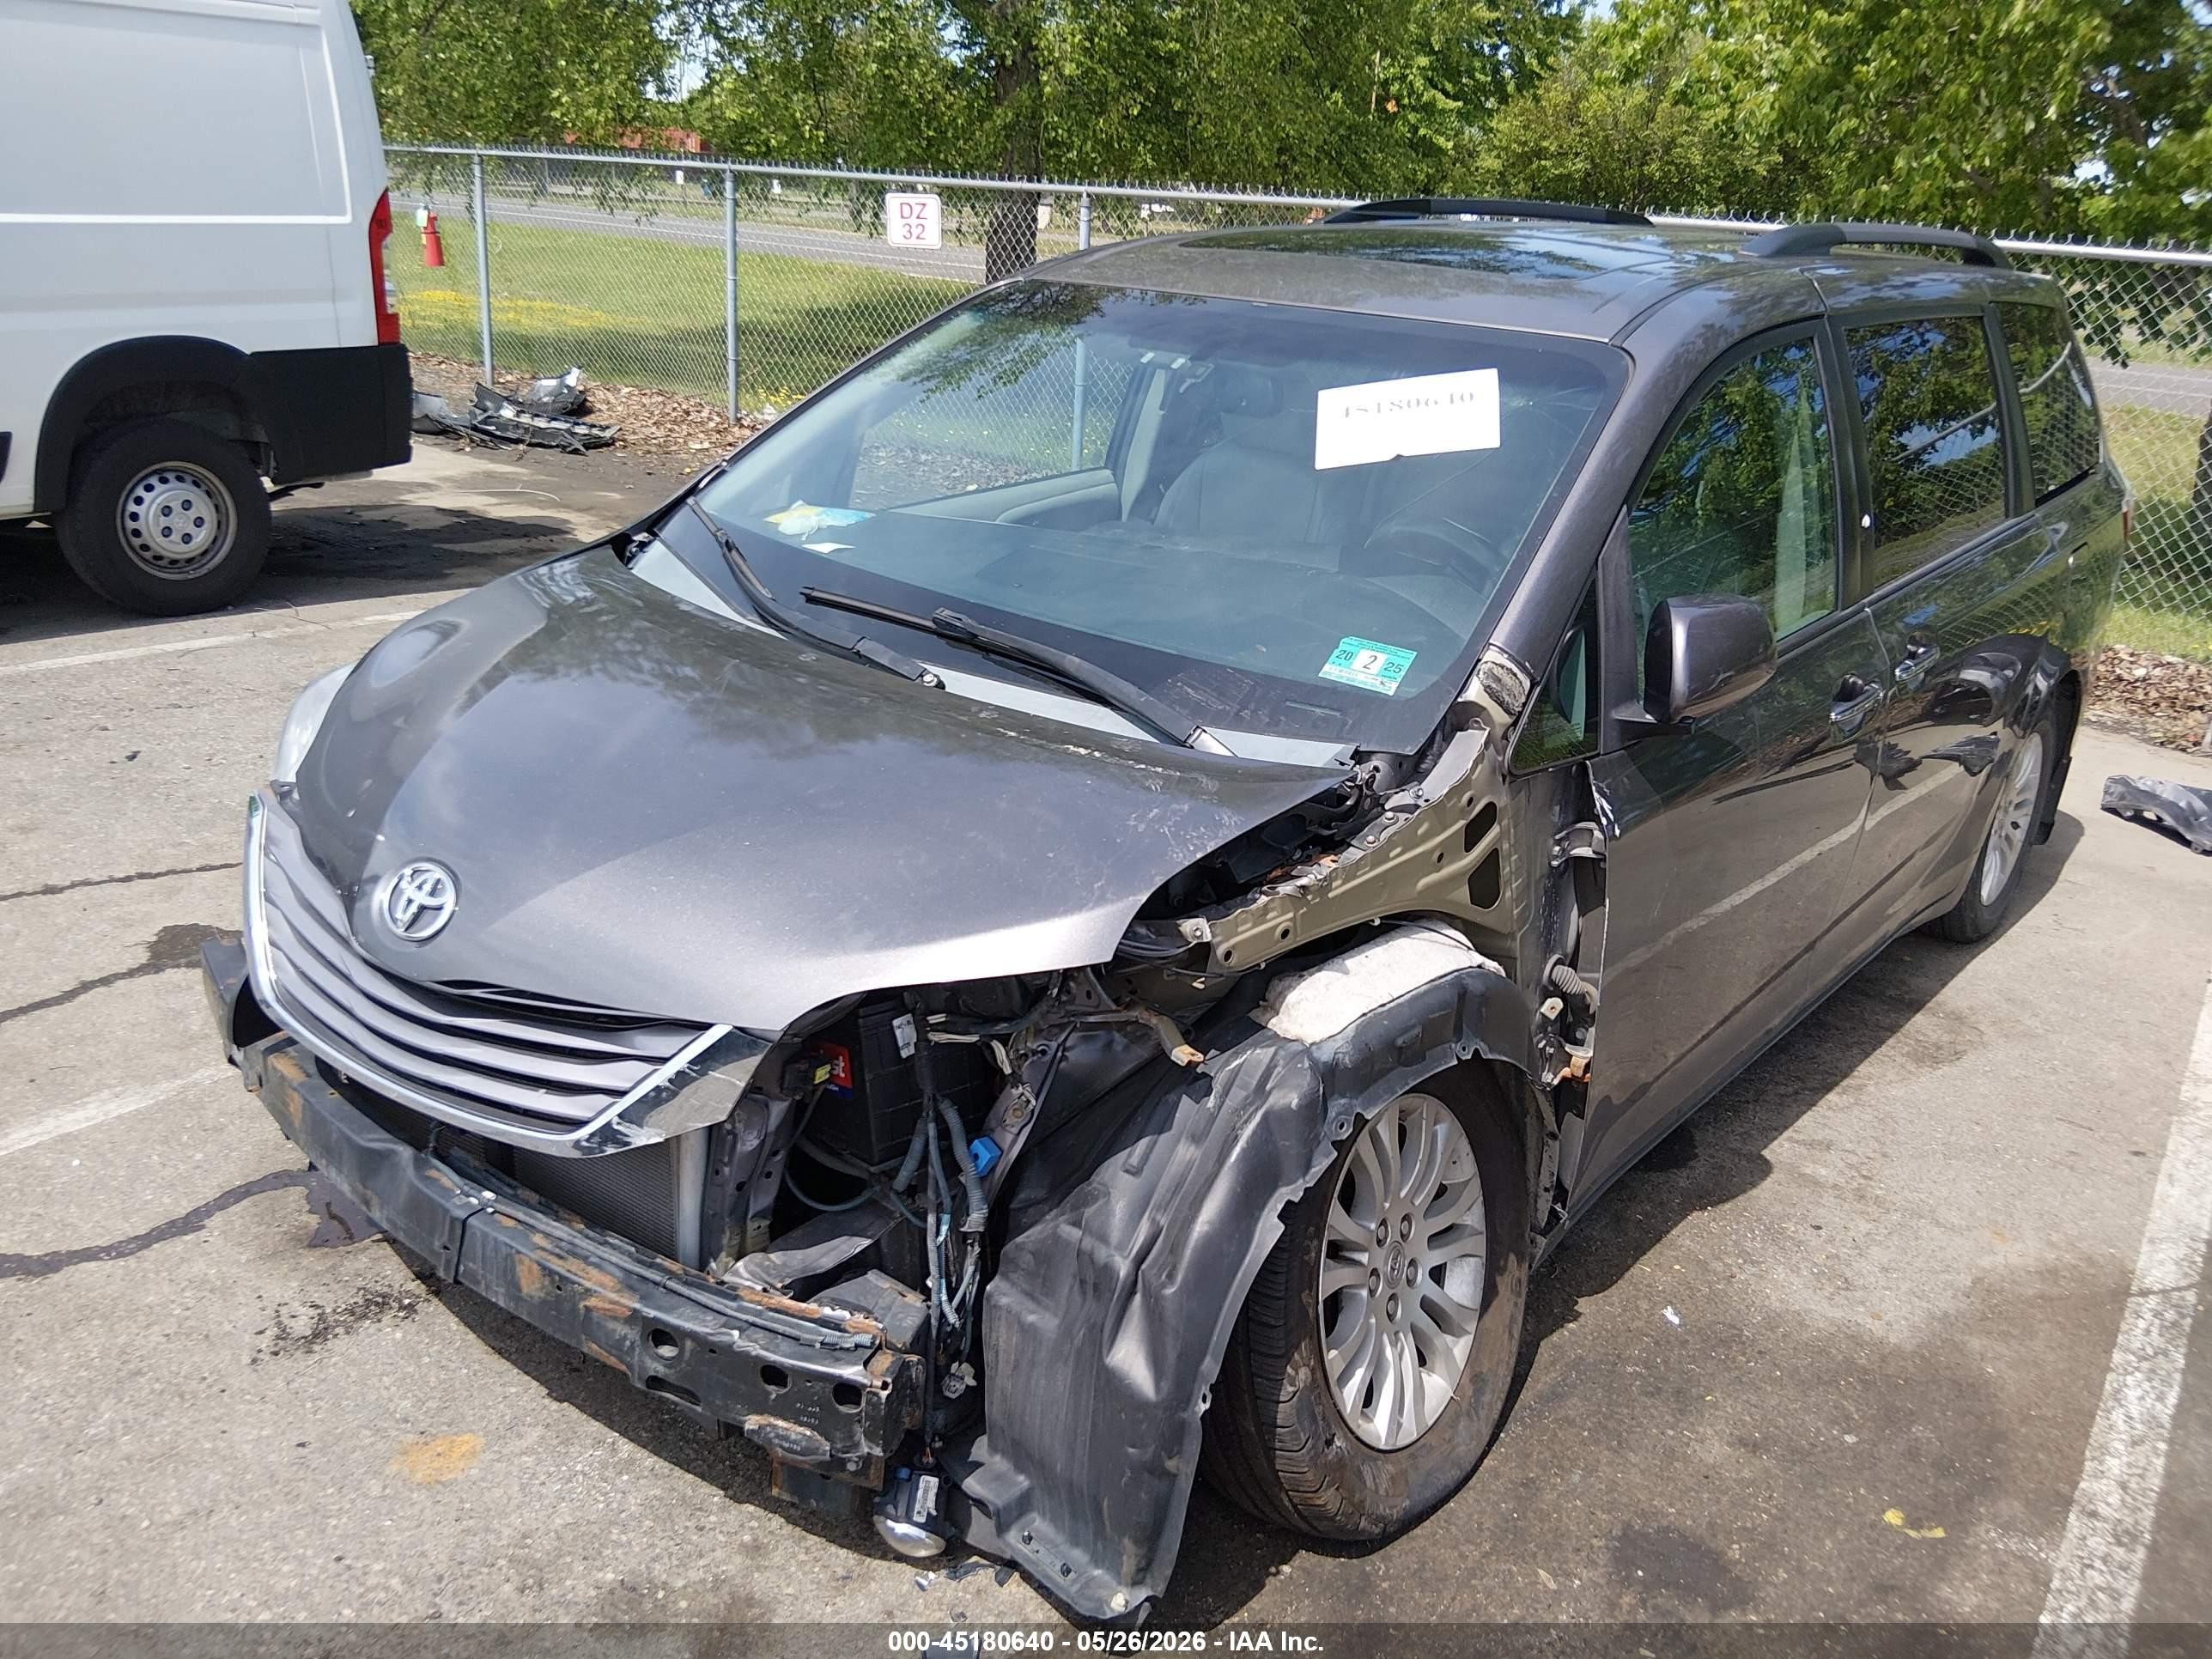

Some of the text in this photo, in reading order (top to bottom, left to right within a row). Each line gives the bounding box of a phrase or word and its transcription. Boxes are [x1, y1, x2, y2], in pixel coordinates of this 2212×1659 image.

[899, 202, 928, 220] DZ
[902, 223, 927, 240] 32
[1334, 649, 1405, 674] 20 2 25
